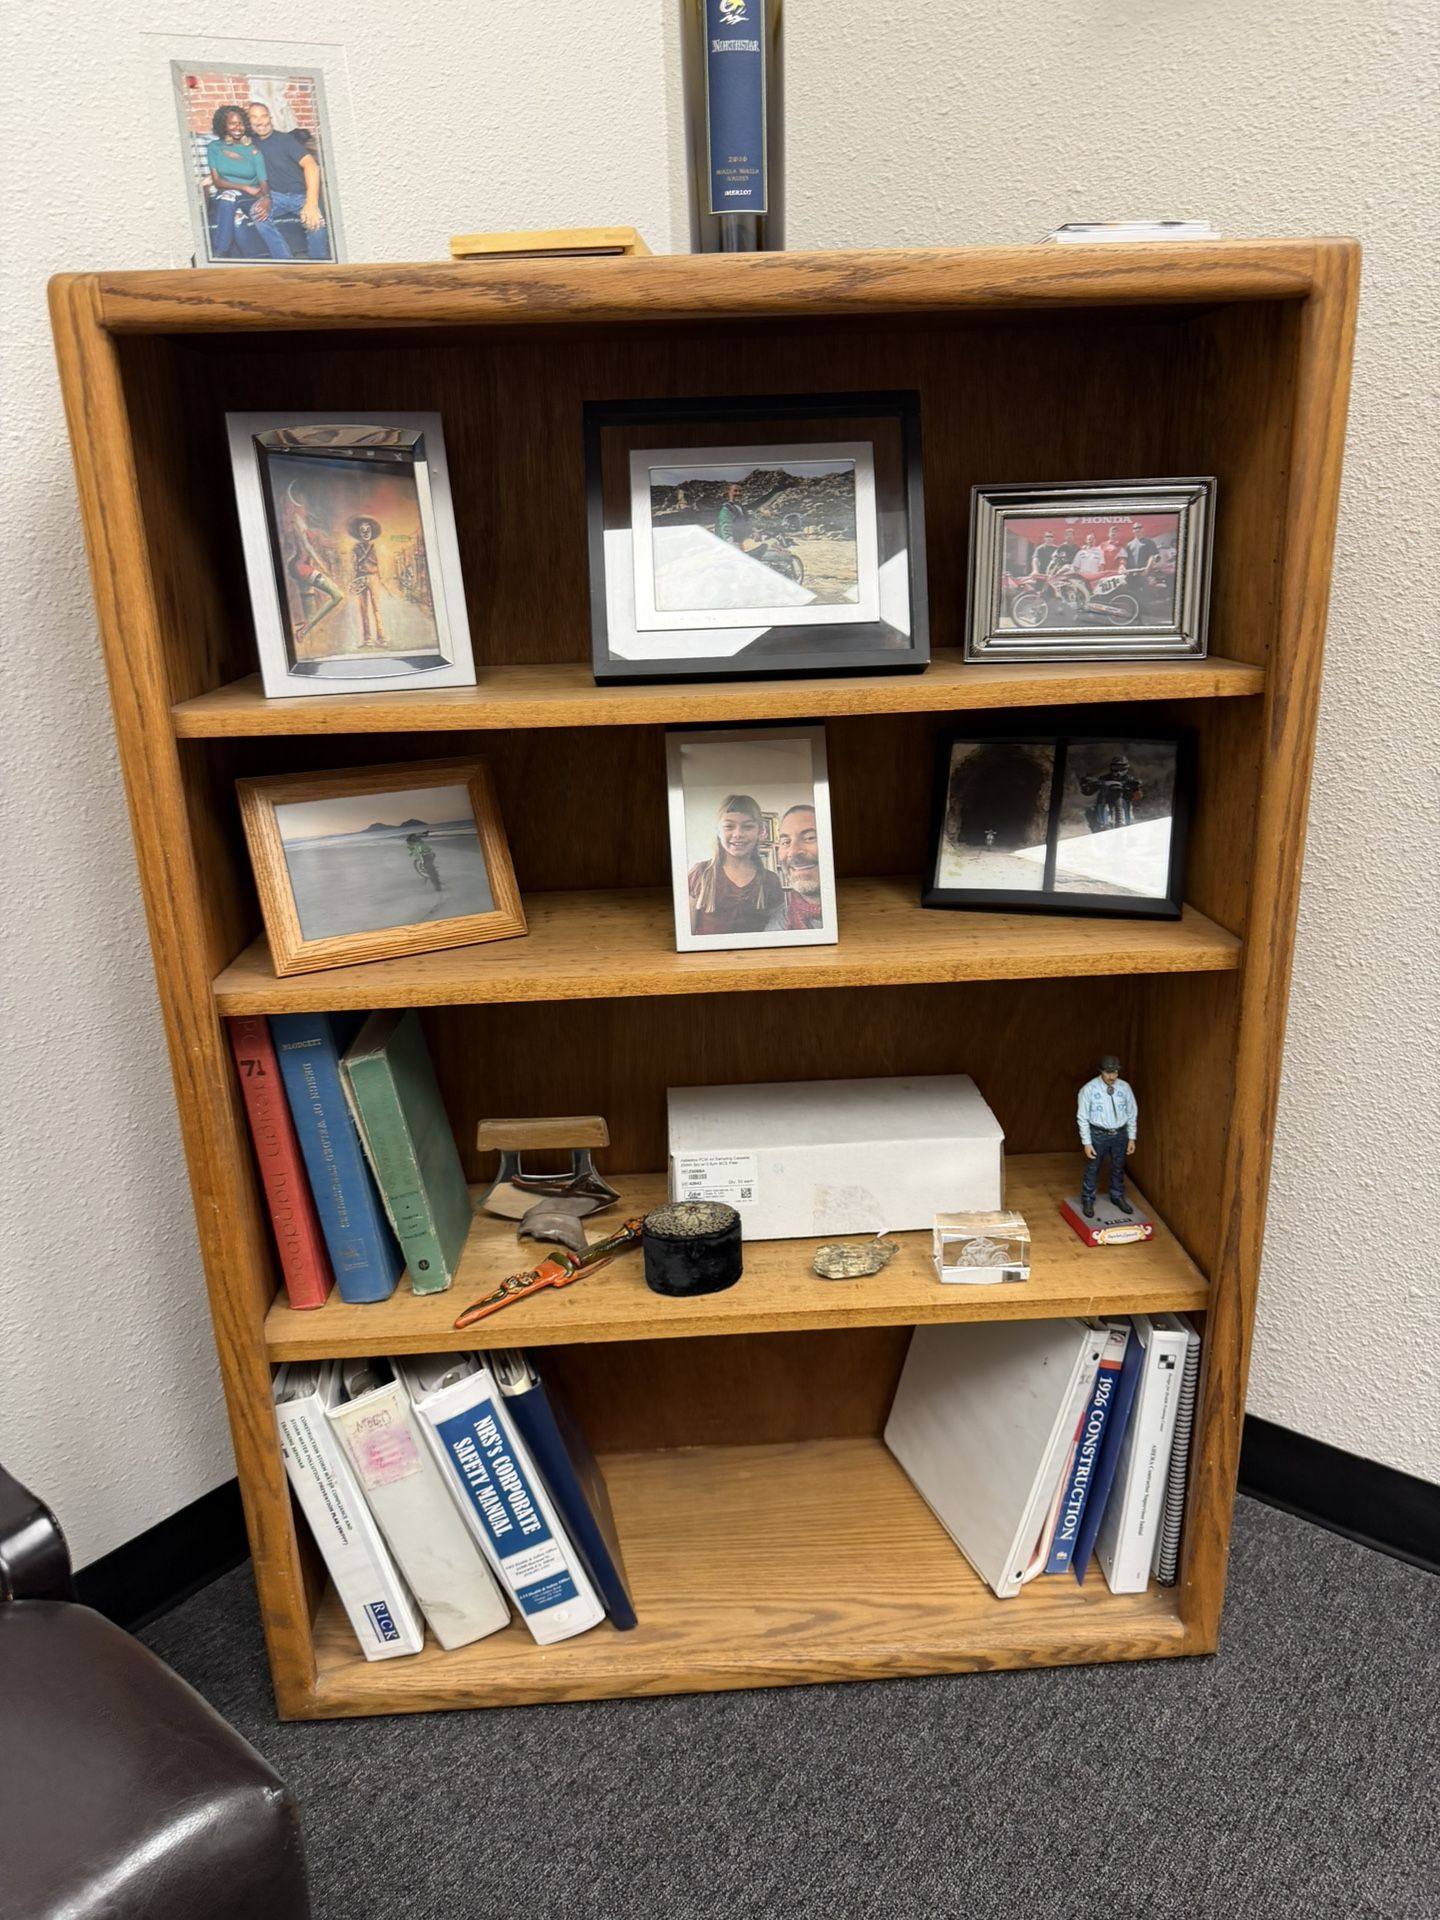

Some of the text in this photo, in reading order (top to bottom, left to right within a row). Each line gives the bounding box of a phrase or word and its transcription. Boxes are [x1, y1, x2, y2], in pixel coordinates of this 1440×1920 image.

[1081, 515, 1133, 524] HONDA
[302, 1063, 320, 1099] DESIGN
[312, 1102, 324, 1116] OF
[299, 1415, 319, 1454] CONSTRUCTION
[1058, 1376, 1114, 1540] 1926 CONSTRUCTION
[451, 1435, 514, 1537] SAFETY MANUAL
[489, 1452, 542, 1535] CORPORATE
[330, 1510, 339, 1524] PLAN
[372, 1602, 398, 1640] RICK
